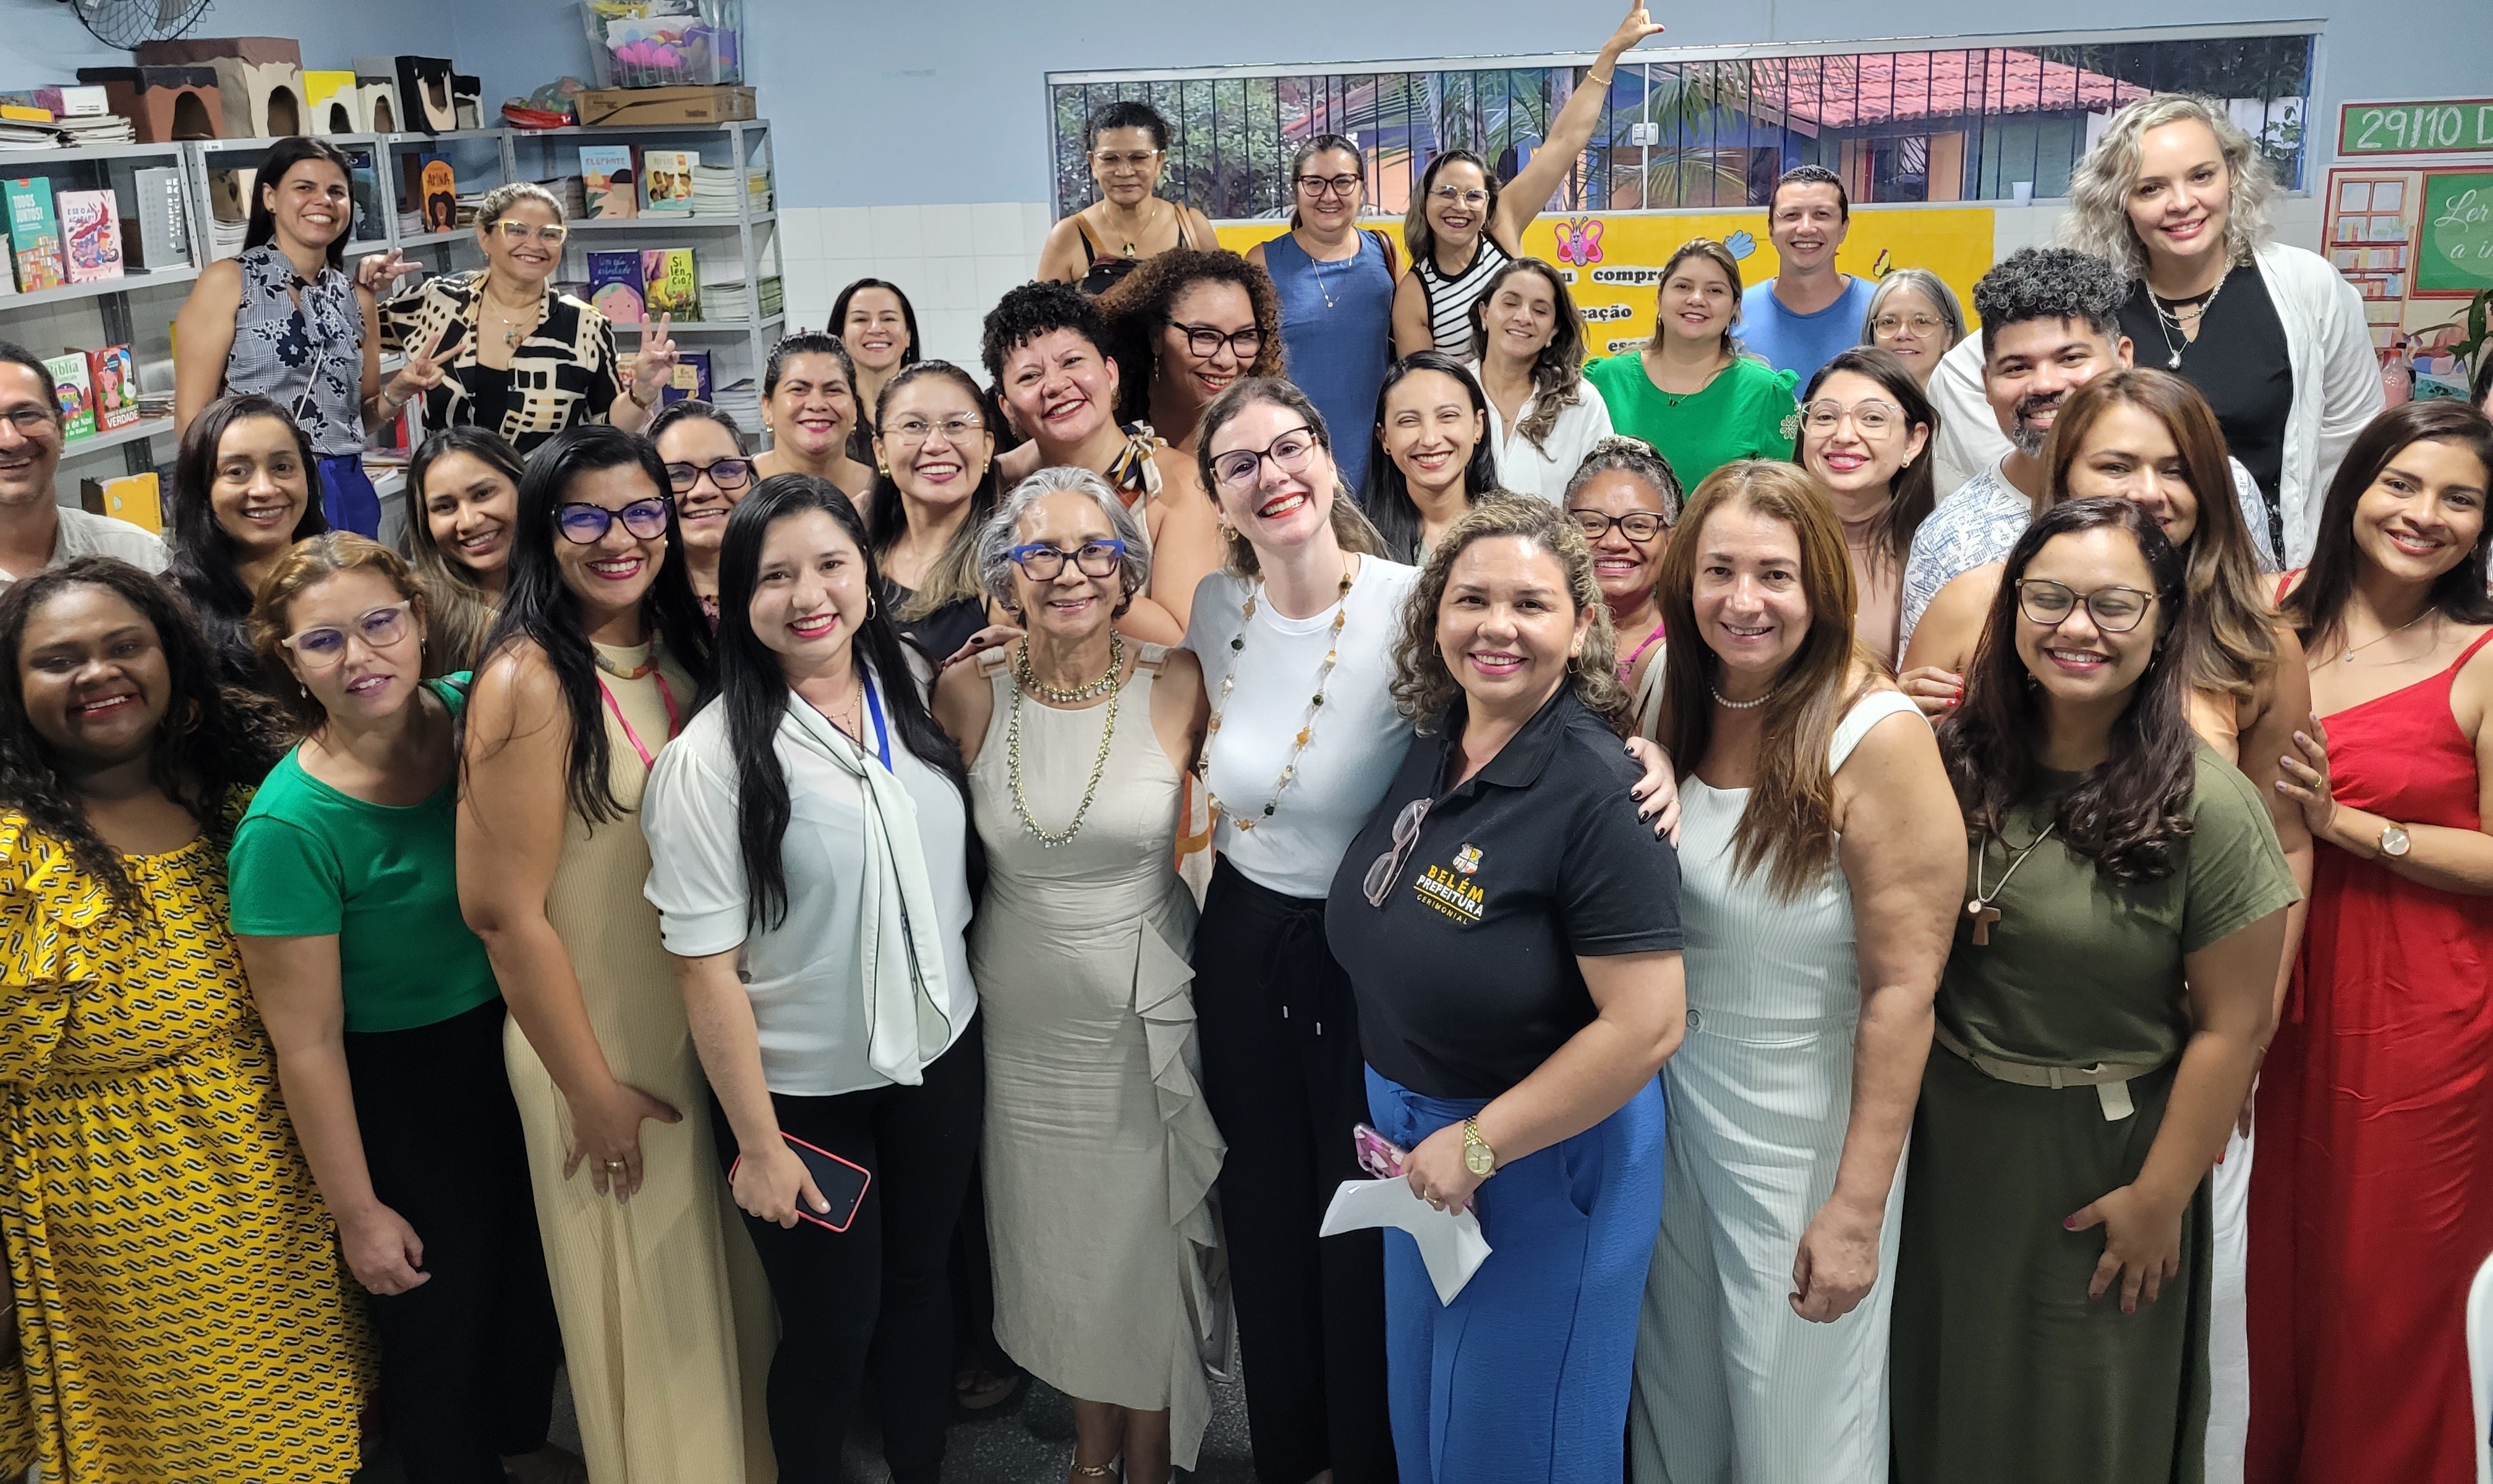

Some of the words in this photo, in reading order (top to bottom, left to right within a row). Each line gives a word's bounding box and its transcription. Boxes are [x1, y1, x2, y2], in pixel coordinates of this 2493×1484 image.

[2356, 106, 2462, 148] 29/10
[13, 194, 35, 209] TODOS
[2434, 189, 2489, 232] Ler
[2450, 244, 2466, 258] a
[672, 256, 682, 267] Si
[670, 265, 685, 276] len
[672, 273, 691, 285] cio?
[1593, 270, 1664, 284] compro
[1579, 304, 1632, 321] cação
[106, 409, 139, 428] VERDADE
[1427, 864, 1483, 903] BELÉM
[1416, 874, 1483, 917] PREFEITURA
[1417, 894, 1468, 925] CERIMONIAL
